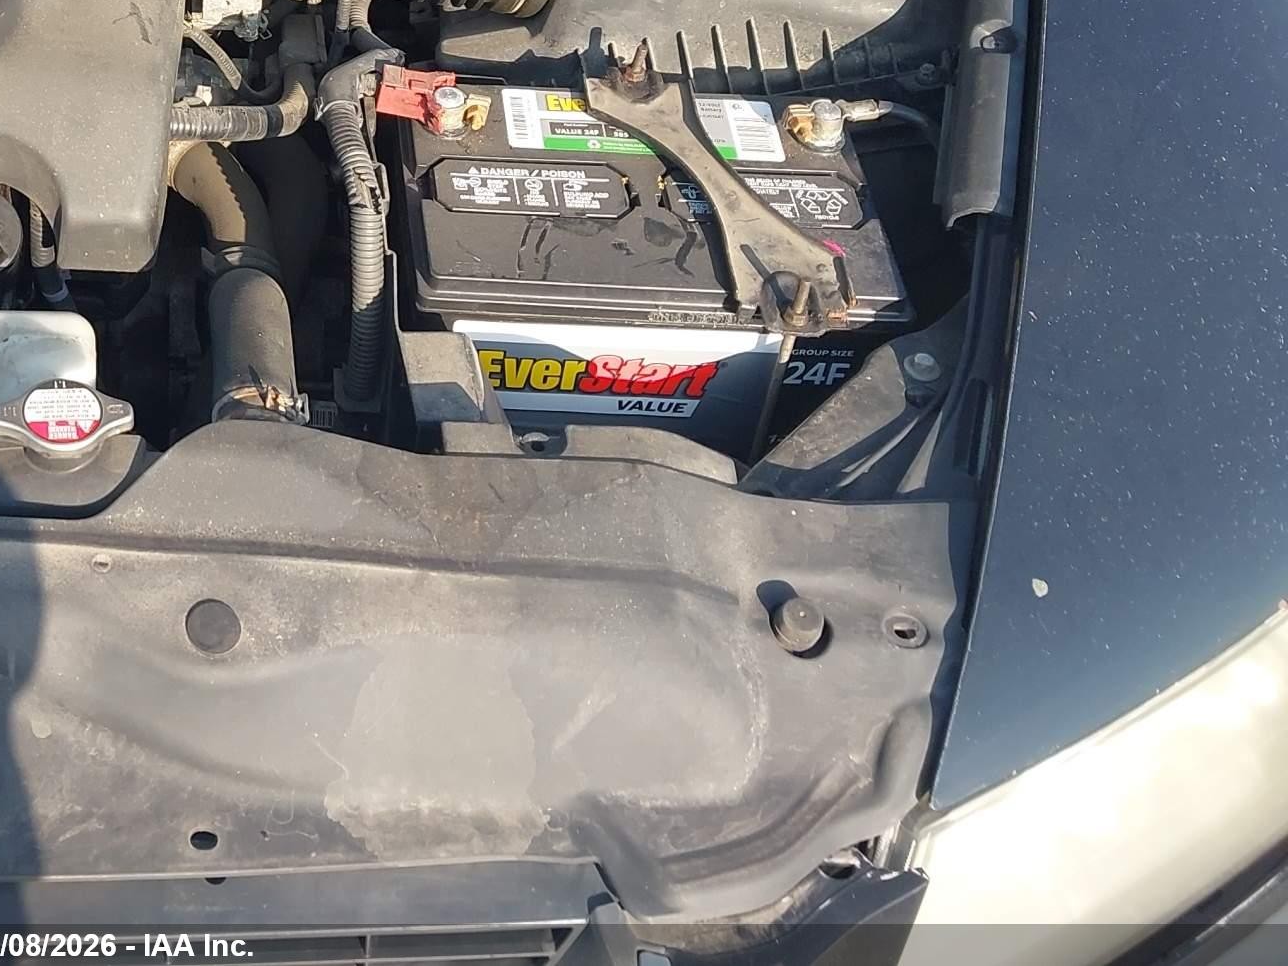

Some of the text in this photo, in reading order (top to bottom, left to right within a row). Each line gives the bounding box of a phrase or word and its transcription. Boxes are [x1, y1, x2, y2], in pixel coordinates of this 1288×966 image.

[480, 167, 530, 176] DANGER
[541, 170, 586, 179] POISON
[791, 348, 829, 356] GROUP
[478, 349, 719, 397] EverStart
[782, 361, 851, 385] 24F
[617, 399, 688, 414] VALUE
